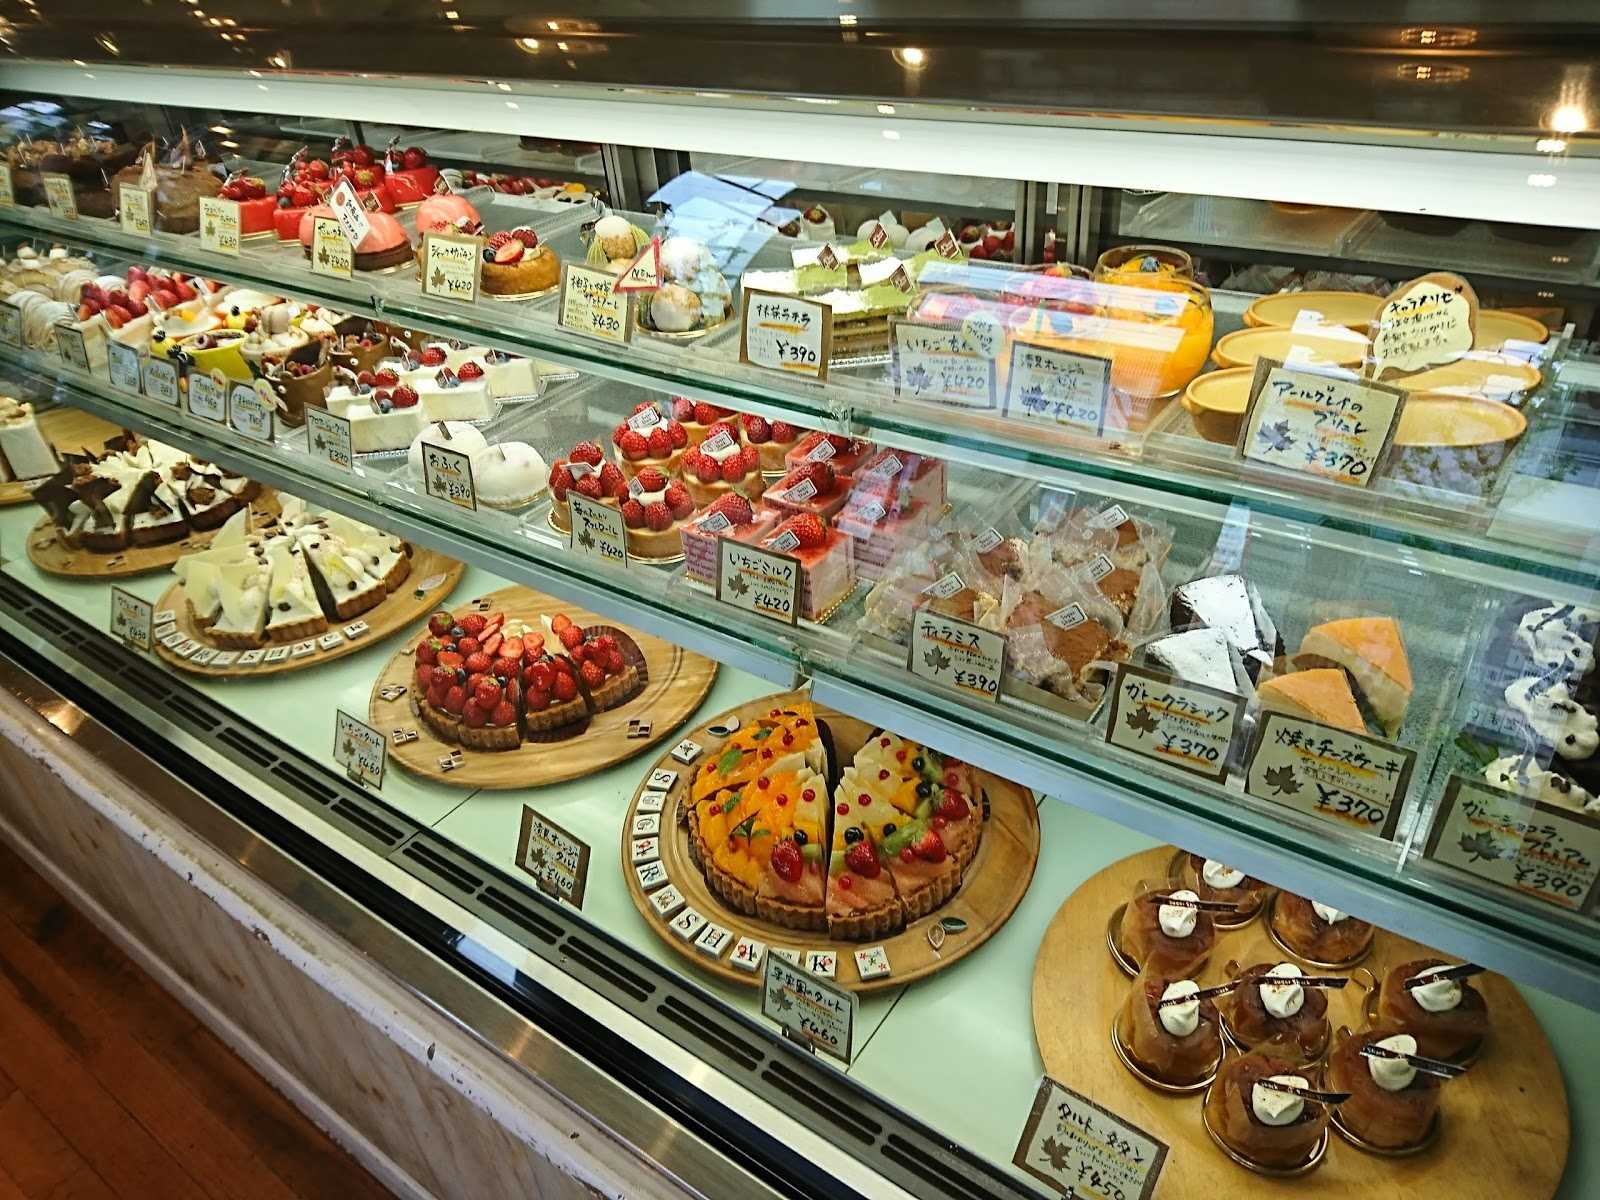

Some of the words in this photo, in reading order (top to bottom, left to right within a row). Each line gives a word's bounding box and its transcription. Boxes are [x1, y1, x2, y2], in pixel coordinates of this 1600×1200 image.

[448, 279, 473, 291] ¥420
[592, 312, 620, 331] ¥430
[776, 339, 817, 363] ¥390
[941, 371, 986, 392] ¥420
[1273, 380, 1363, 413] アールグレイの
[430, 453, 463, 474] おふく
[1305, 442, 1367, 477] ¥370
[449, 482, 471, 498] ¥390
[600, 540, 624, 559] ¥420
[729, 552, 792, 580] いちごミルク
[754, 589, 791, 612] ¥420
[921, 620, 981, 651] ティラミス
[953, 668, 998, 692] ¥390
[1125, 683, 1230, 723] ガトークラシック
[1161, 730, 1220, 762] ¥370
[1274, 727, 1400, 781] 焼きチーズケーキ
[358, 753, 380, 776] ¥460
[1316, 783, 1385, 824] ¥370
[556, 851, 577, 869] タルト
[547, 866, 573, 890] ¥460
[1513, 863, 1583, 898] ¥390
[798, 1012, 839, 1045] ¥460
[1058, 1103, 1145, 1164] タルト・タタン
[1078, 1160, 1127, 1200] ¥450
